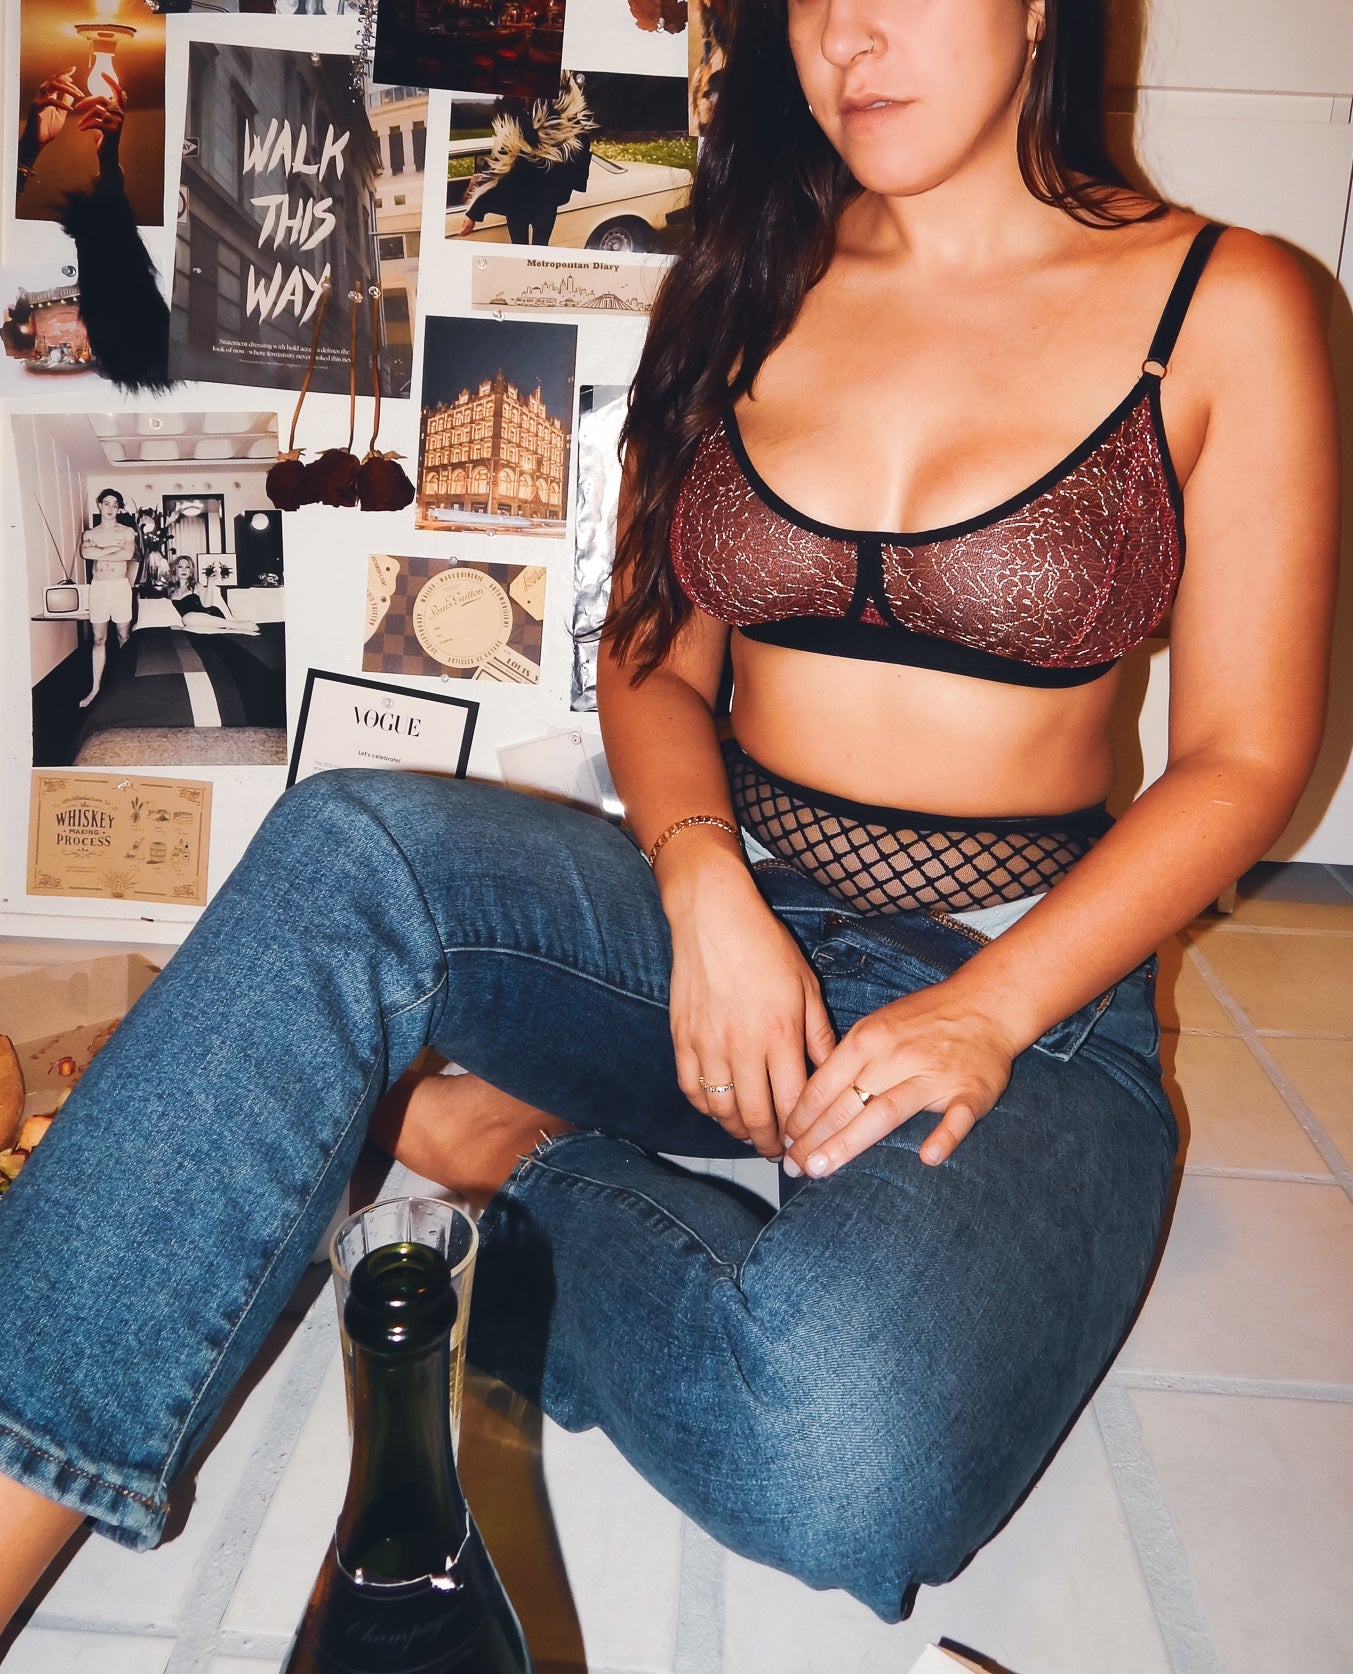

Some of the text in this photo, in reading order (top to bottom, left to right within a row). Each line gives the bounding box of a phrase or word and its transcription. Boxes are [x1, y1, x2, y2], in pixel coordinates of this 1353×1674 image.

[242, 118, 350, 182] WALK
[250, 194, 336, 251] THIS
[526, 259, 620, 272] Metropolitan Diary
[246, 262, 332, 327] WAY
[506, 658, 530, 677] LOUIS
[354, 706, 422, 737] VOGUE
[371, 753, 401, 764] celebrate!
[56, 808, 114, 828] WHISKEY
[56, 833, 112, 847] PROCESS
